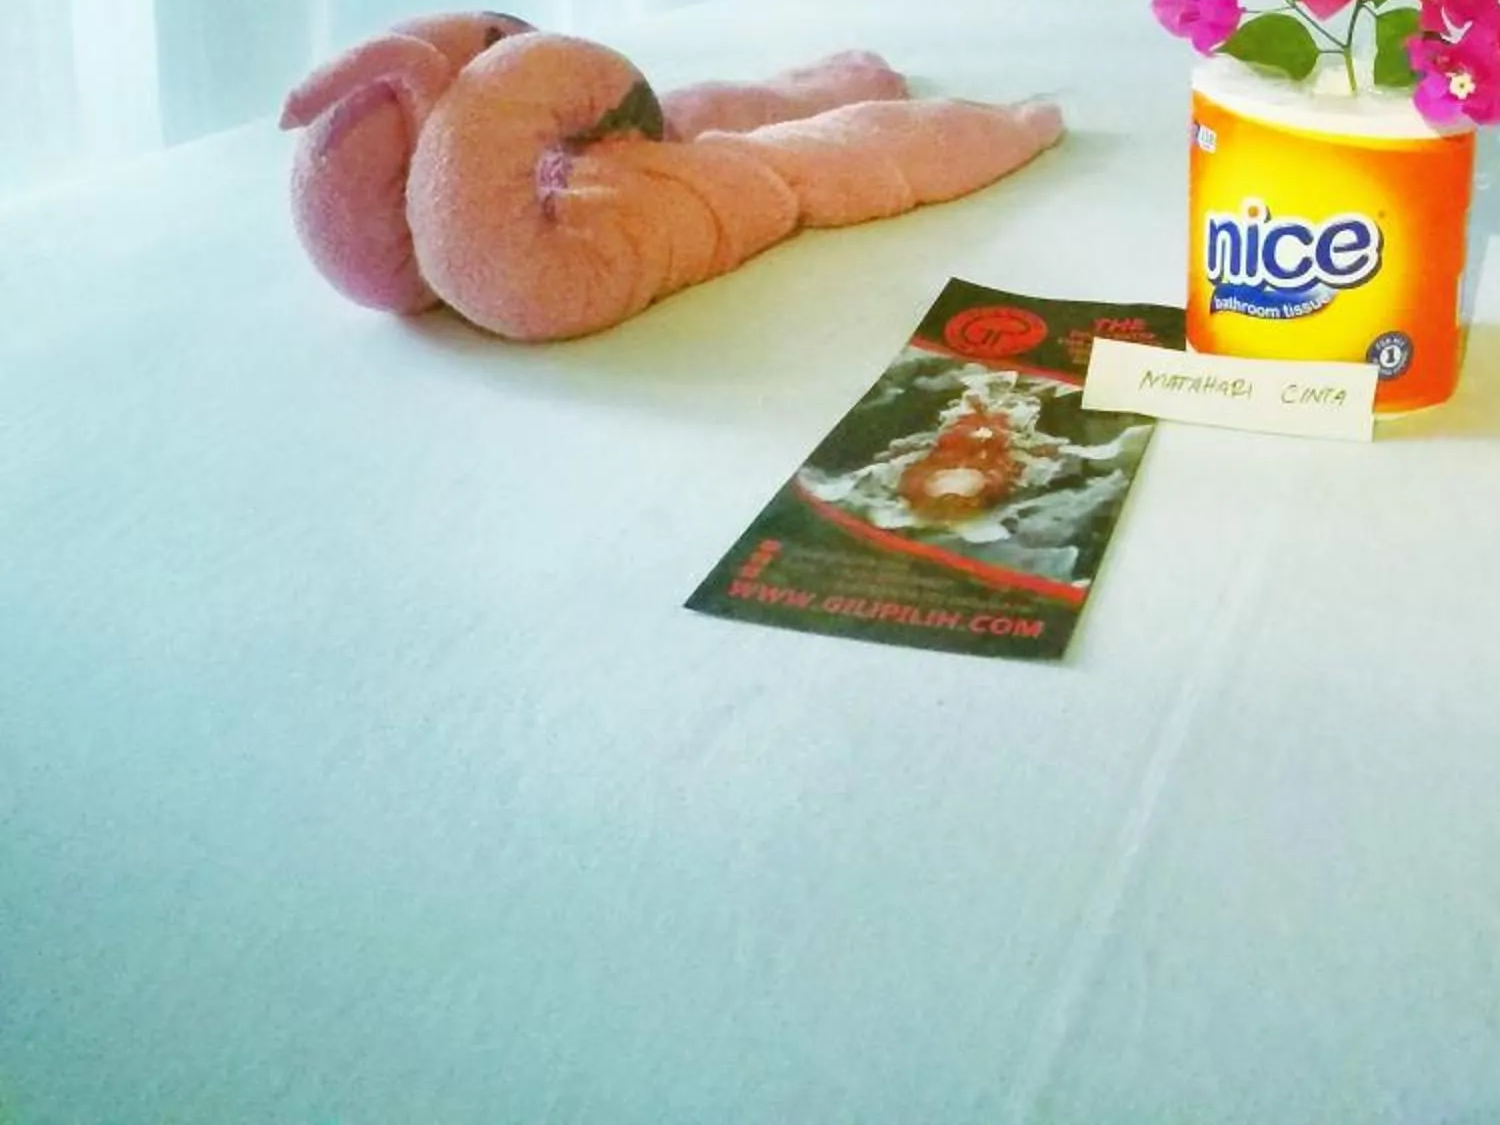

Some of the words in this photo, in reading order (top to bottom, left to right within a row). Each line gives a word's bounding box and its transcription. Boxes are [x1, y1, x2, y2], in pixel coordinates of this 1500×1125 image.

[1206, 201, 1376, 281] nice
[1213, 295, 1281, 318] bathroom
[1280, 383, 1347, 406] CINTA
